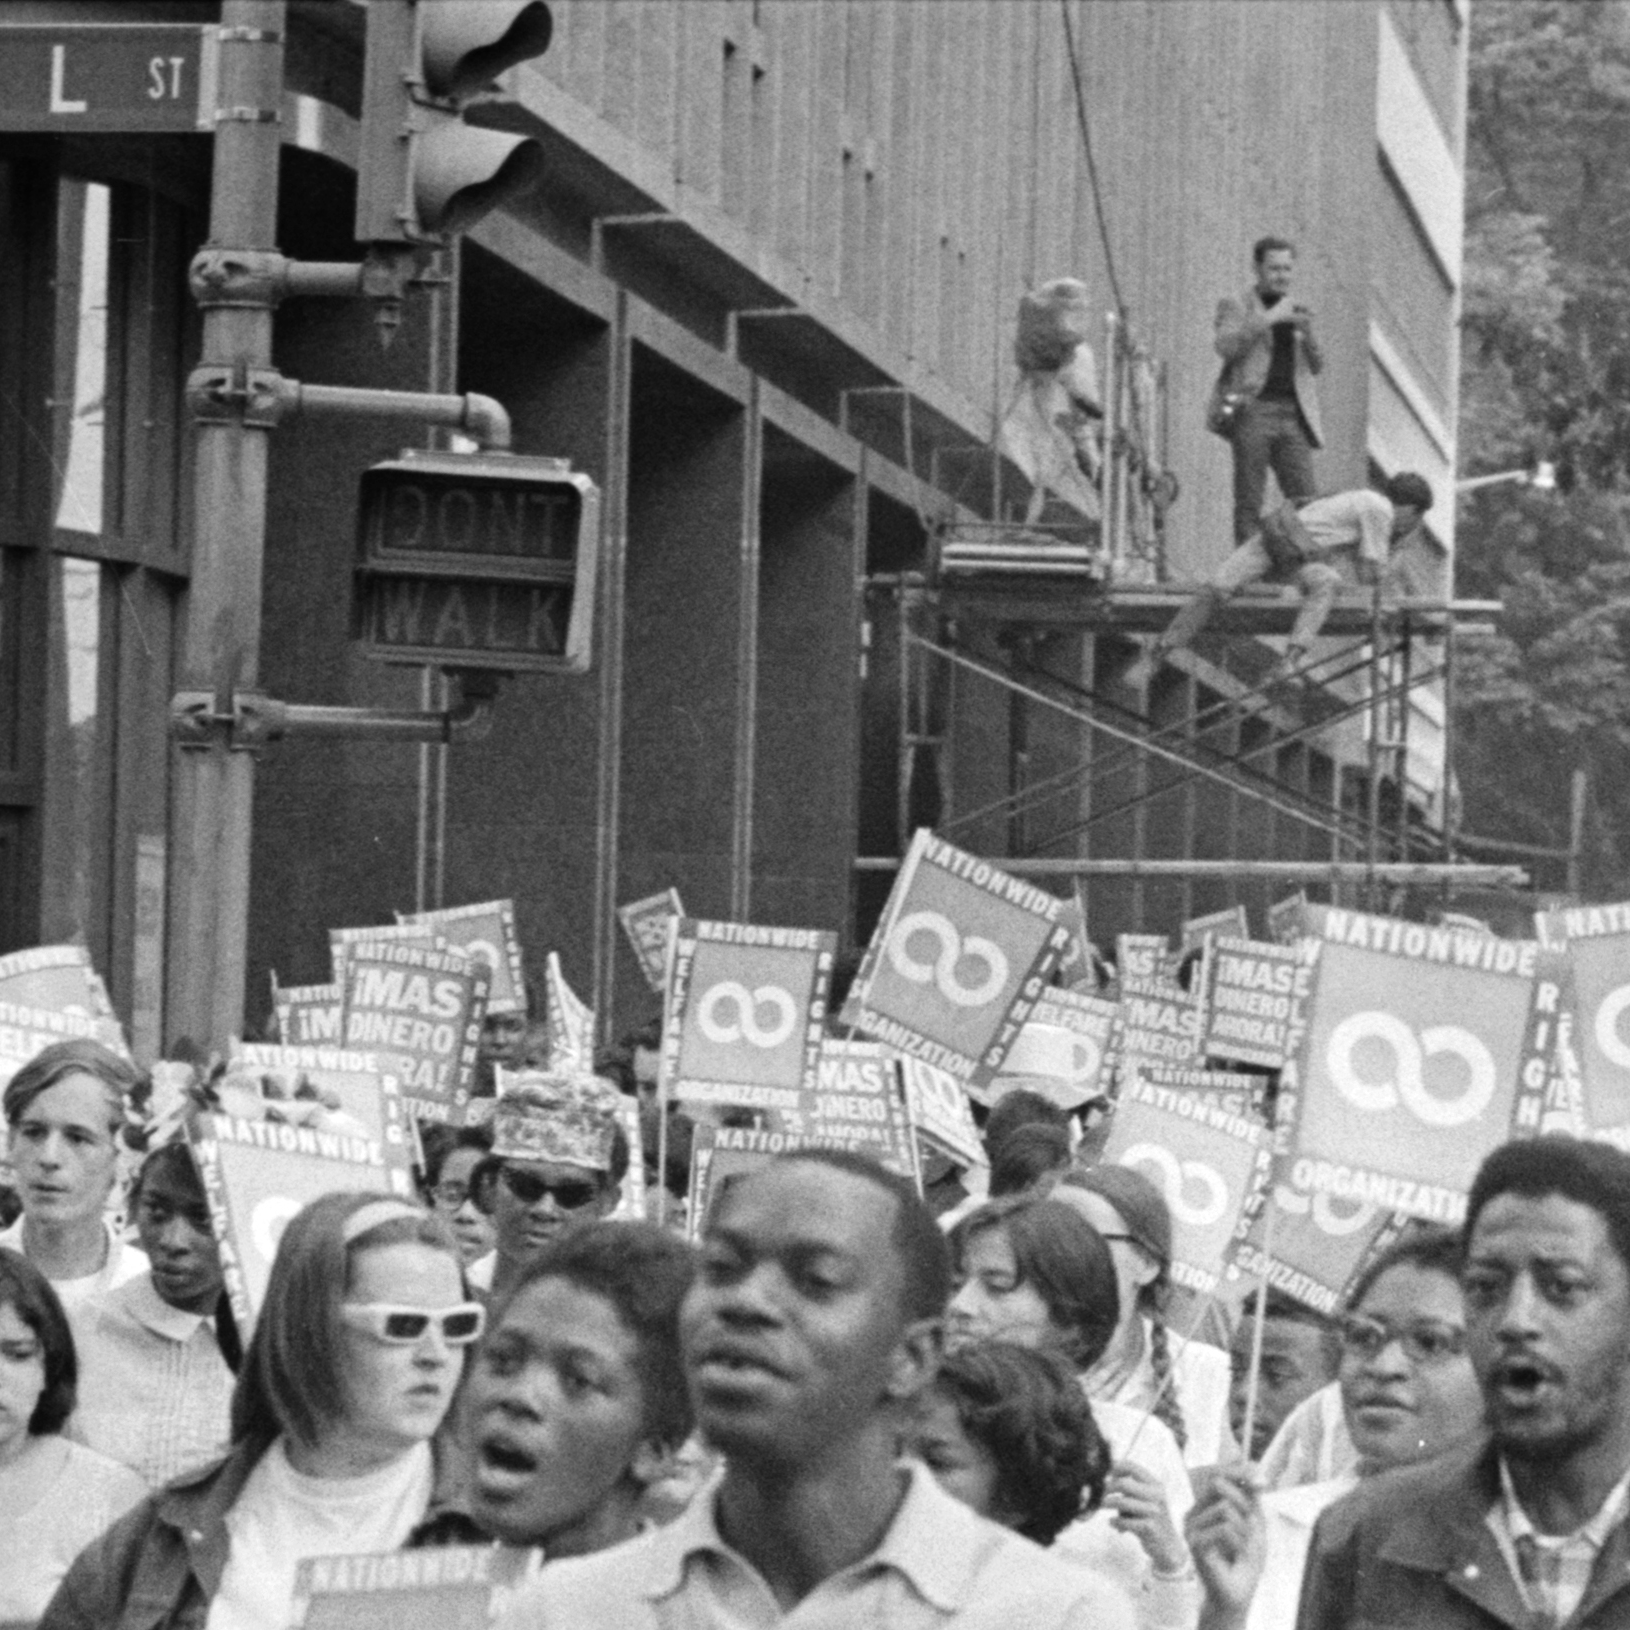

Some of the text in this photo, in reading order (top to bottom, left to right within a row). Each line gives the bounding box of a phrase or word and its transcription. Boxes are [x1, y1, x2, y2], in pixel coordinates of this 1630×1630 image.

[51, 45, 87, 112] L
[148, 57, 184, 99] ST
[383, 579, 560, 650] WALK
[922, 834, 1063, 922] NATIONWIDE
[697, 920, 820, 951] NATIONWIDE
[1325, 908, 1538, 978] NATIONWIDE
[803, 951, 832, 1090] RIGHTS
[985, 925, 1070, 1068] RIGHTS
[240, 1045, 379, 1073] ATIONWIDE
[347, 1011, 455, 1055] DINERO
[455, 980, 488, 1106] RIGHTS
[1273, 937, 1322, 1156] WELFARE
[1516, 981, 1560, 1128] RIGH
[213, 1114, 386, 1166] NATIONWIDE
[1131, 1075, 1261, 1145] ATIONWIDE
[1236, 1244, 1341, 1313] GANIZATION
